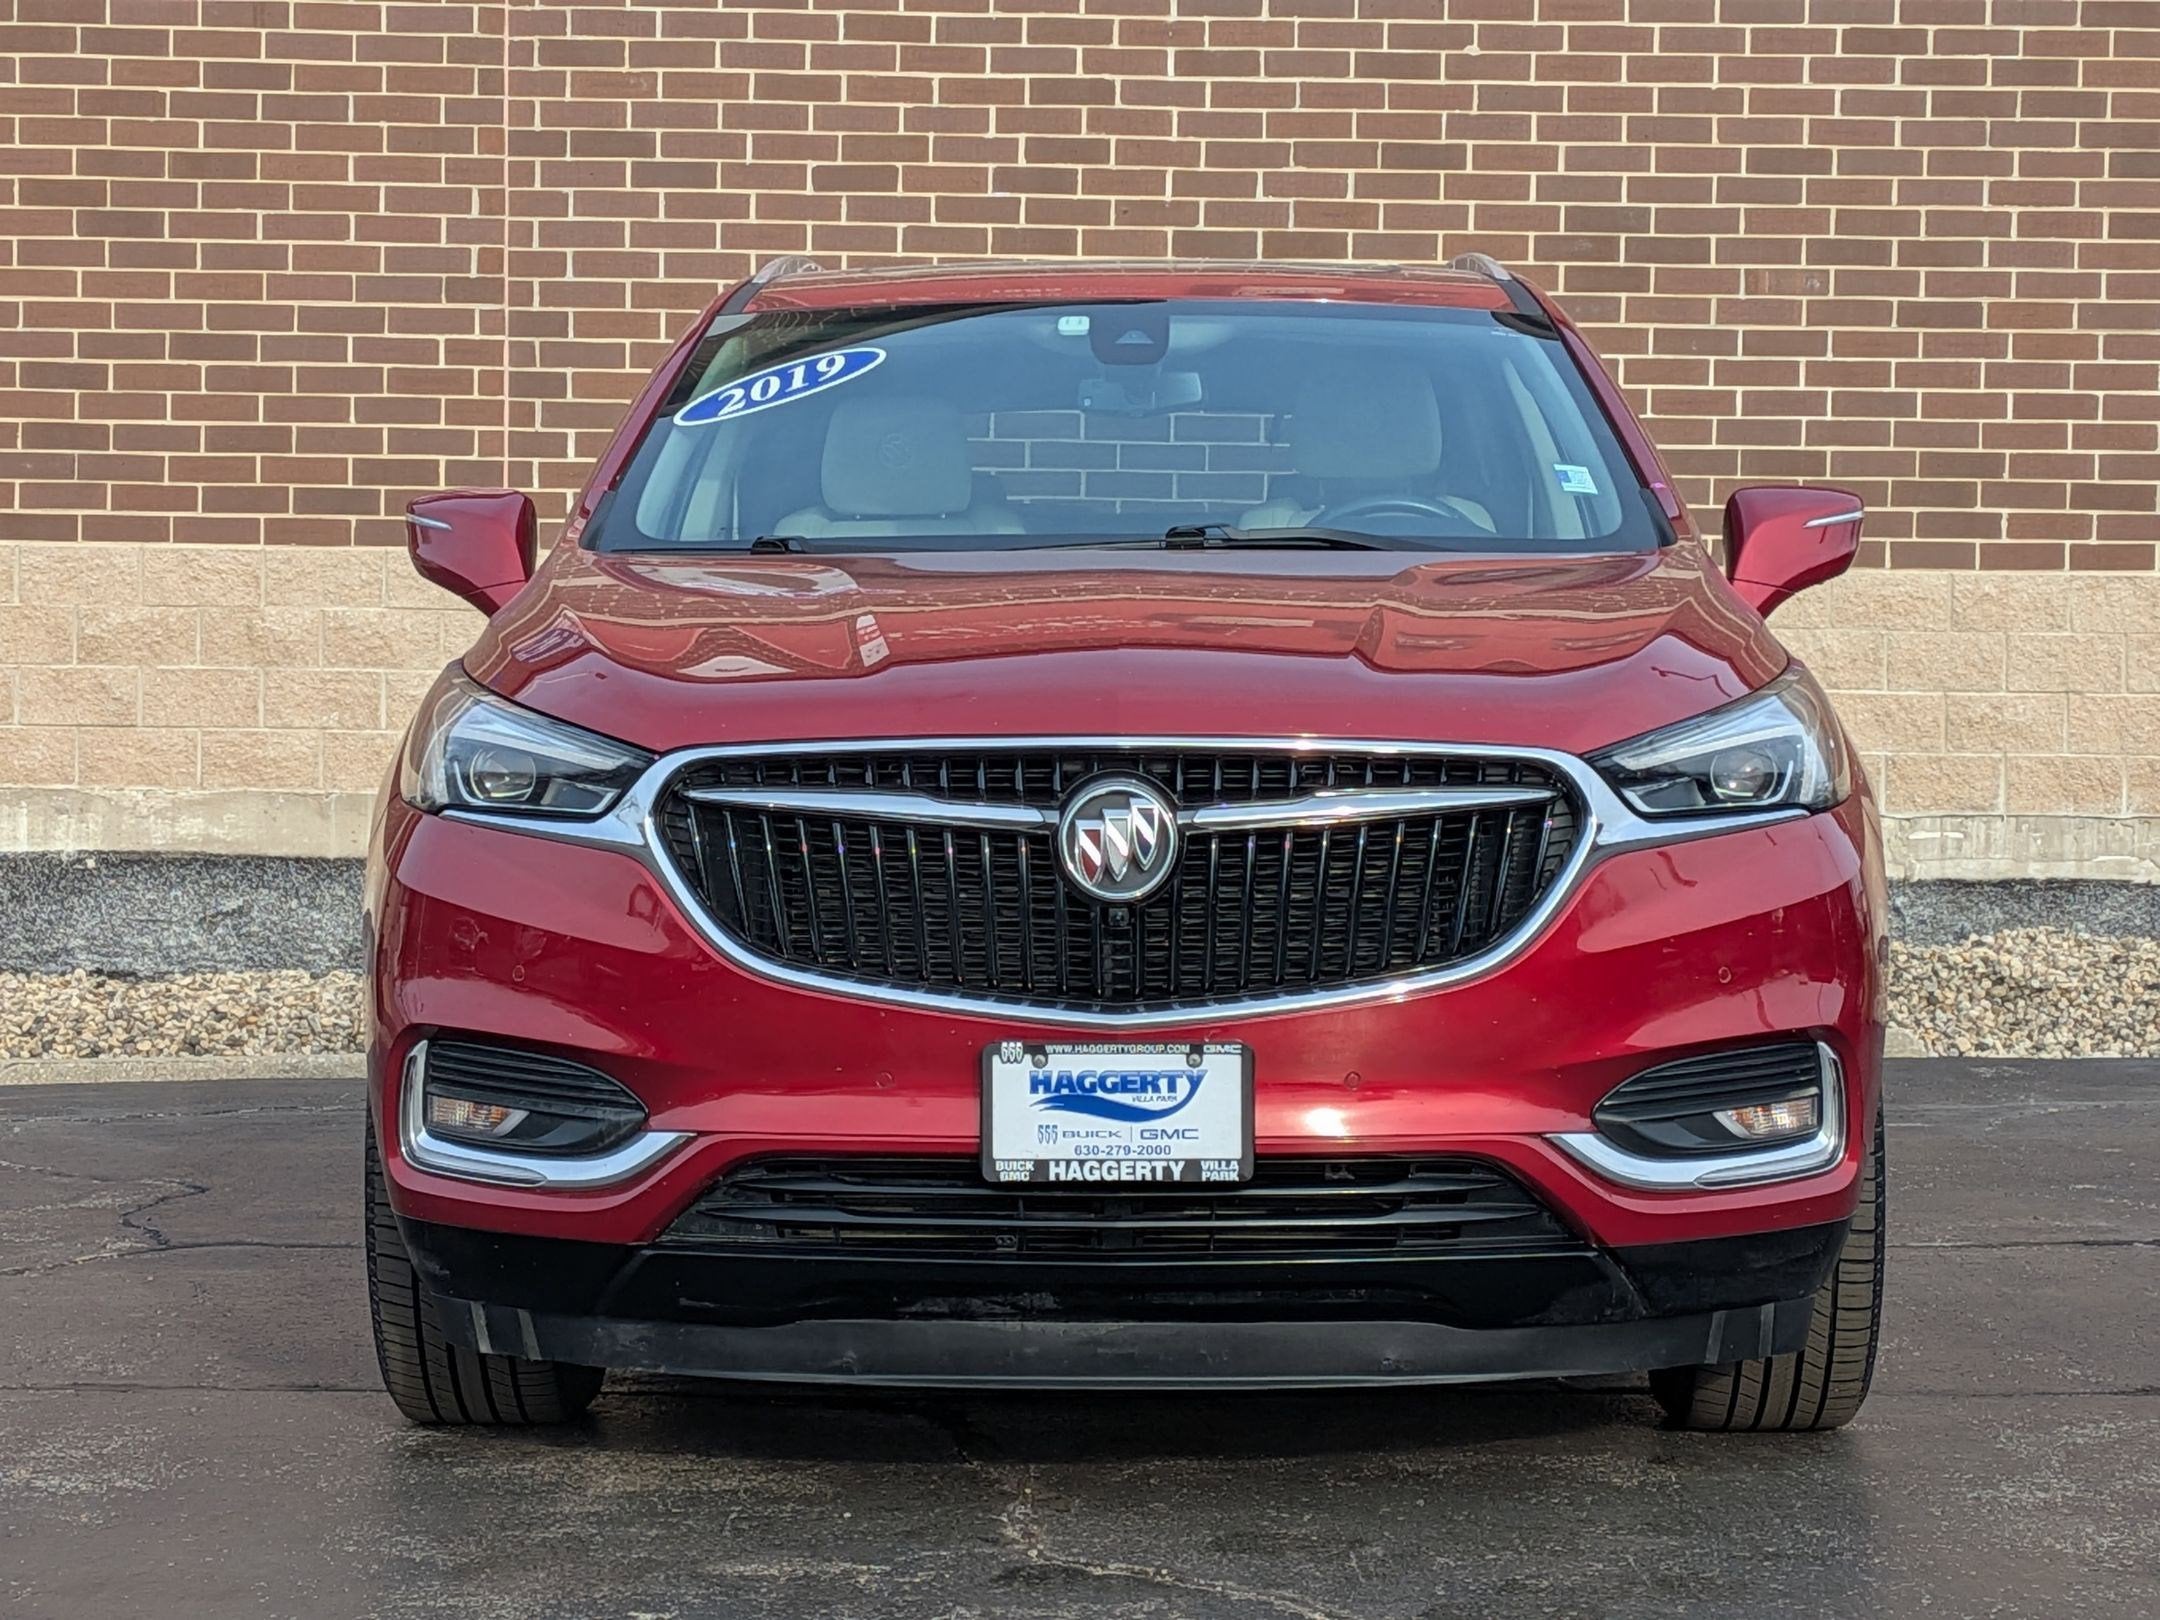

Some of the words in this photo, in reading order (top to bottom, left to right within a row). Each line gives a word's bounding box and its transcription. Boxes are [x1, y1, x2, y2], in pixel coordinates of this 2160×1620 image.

[718, 354, 846, 417] 2019
[1045, 1044, 1190, 1054] WWW.HAGGERTYGROUP.COM
[1203, 1045, 1242, 1054] GMC
[1029, 1069, 1208, 1095] HAGGERTY
[1062, 1130, 1122, 1139] BUICK
[1140, 1129, 1199, 1140] GMC
[1074, 1144, 1172, 1156] 630-279-2000
[995, 1161, 1034, 1171] BUICK
[1049, 1161, 1186, 1182] HAGGERTY
[1200, 1161, 1240, 1171] VILLA
[999, 1171, 1030, 1182] GMC
[1201, 1171, 1240, 1182] PARK
